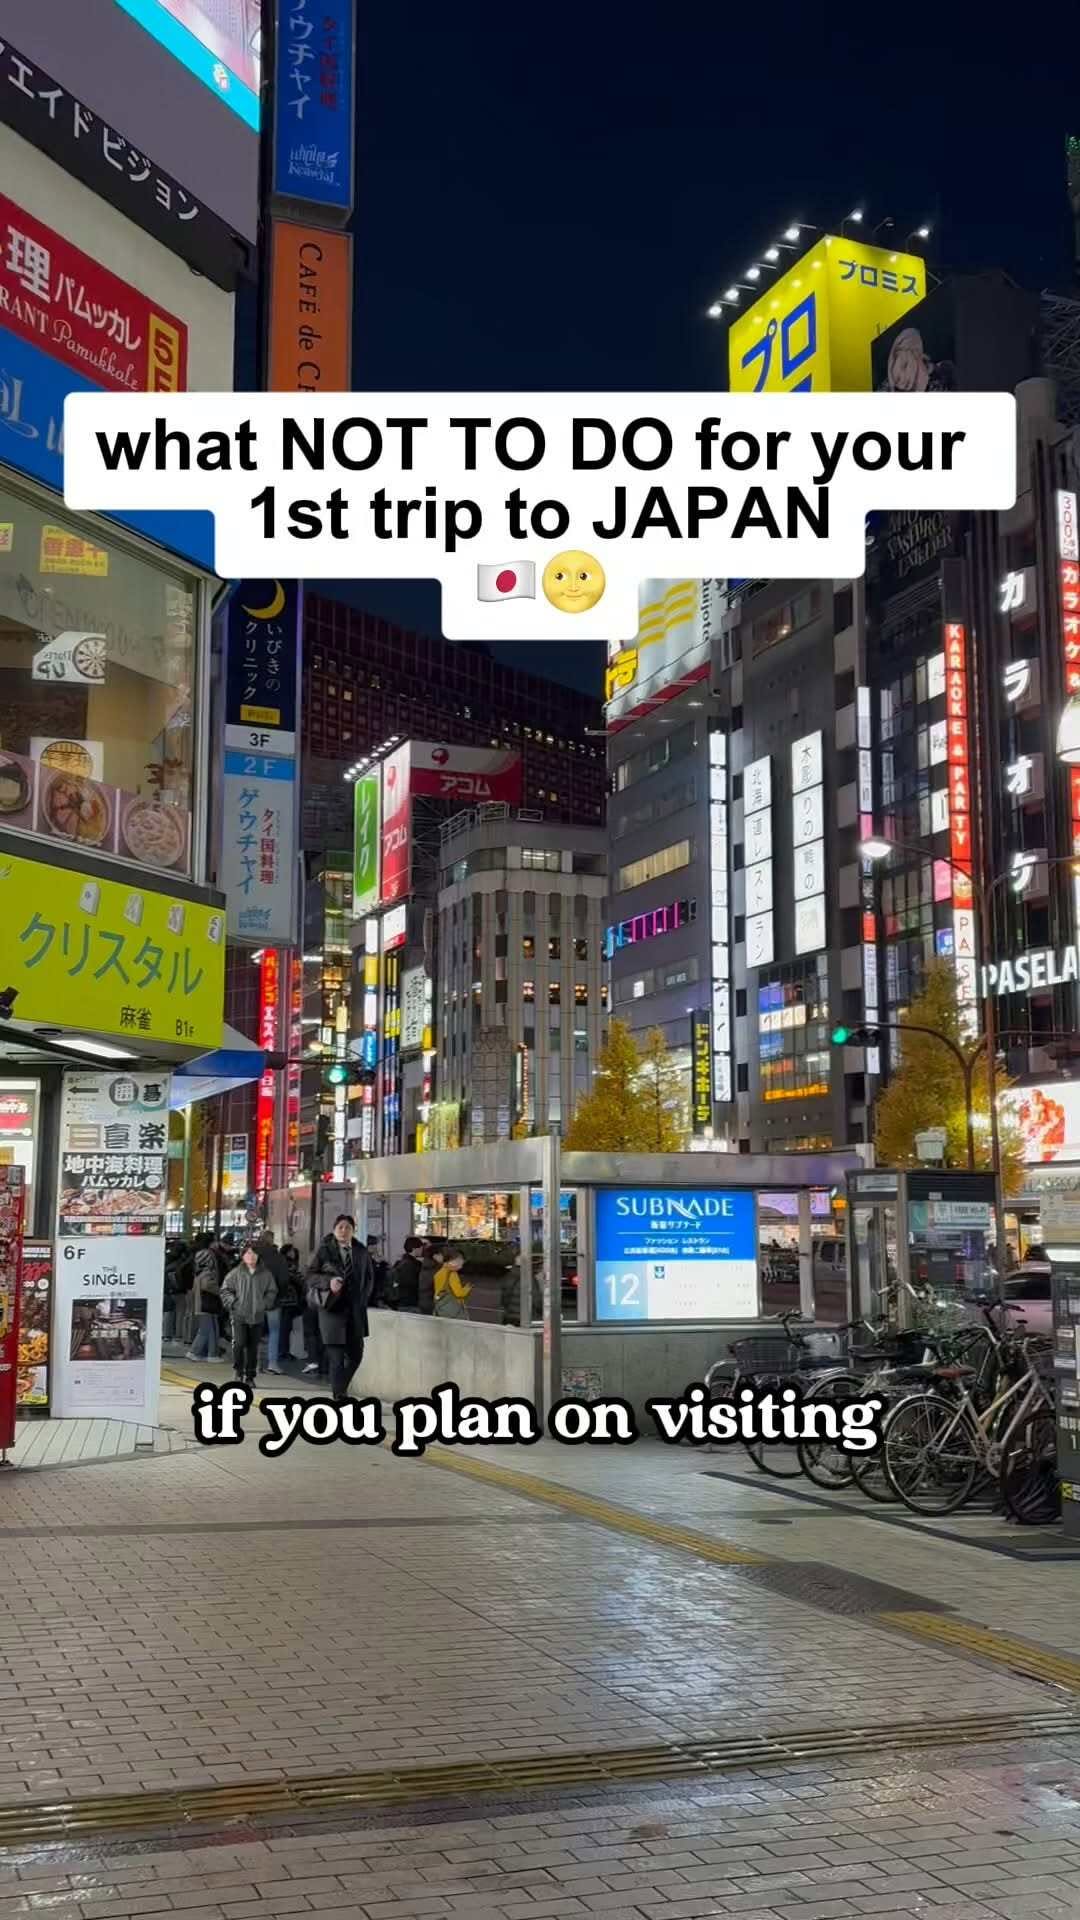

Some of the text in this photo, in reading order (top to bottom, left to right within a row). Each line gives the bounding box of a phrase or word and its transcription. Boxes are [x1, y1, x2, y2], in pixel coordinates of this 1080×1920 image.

[287, 0, 315, 119] ウチャイ
[0, 44, 199, 220] エイドビジョン
[839, 259, 919, 297] プロミス
[298, 325, 322, 351] de
[242, 622, 258, 701] クリニック
[264, 622, 284, 692] いびきの
[249, 732, 271, 748] 3F
[1001, 571, 1037, 891] カラオケ
[440, 775, 491, 797] アコム
[236, 788, 260, 895] ゲウチャイ
[360, 783, 371, 879] レイク
[384, 825, 407, 857] アコム
[19, 911, 204, 996] クリスタル
[981, 944, 1080, 999] PASELA
[120, 1005, 152, 1031] 麻雀
[175, 1016, 196, 1038] B1F
[64, 1155, 164, 1175] 地中海料理
[616, 1196, 735, 1219] SUBNADE
[63, 1245, 87, 1261] 6F
[83, 1273, 136, 1287] SINGLE
[605, 1272, 640, 1306] 12
